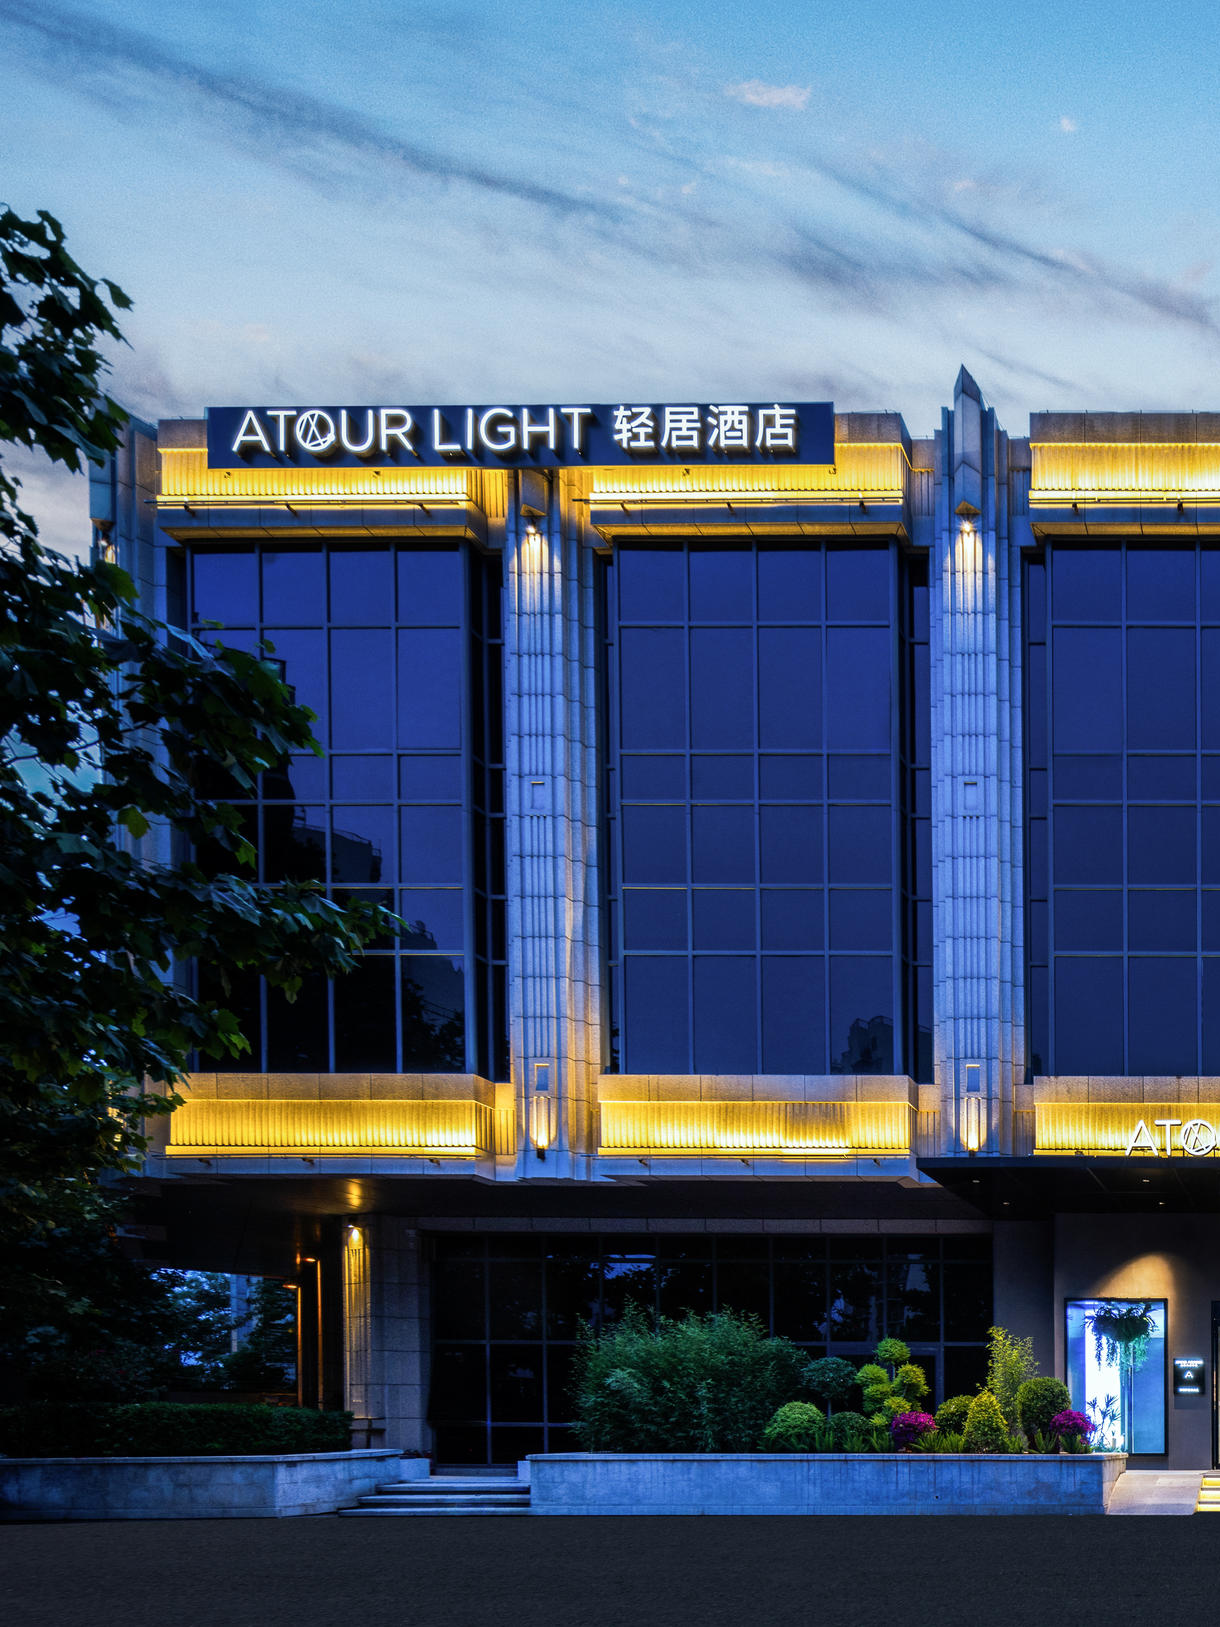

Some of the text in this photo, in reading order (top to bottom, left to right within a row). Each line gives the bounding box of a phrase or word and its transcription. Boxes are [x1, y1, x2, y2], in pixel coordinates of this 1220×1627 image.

[232, 404, 797, 452] ATOUR LIGHT 轻居酒店
